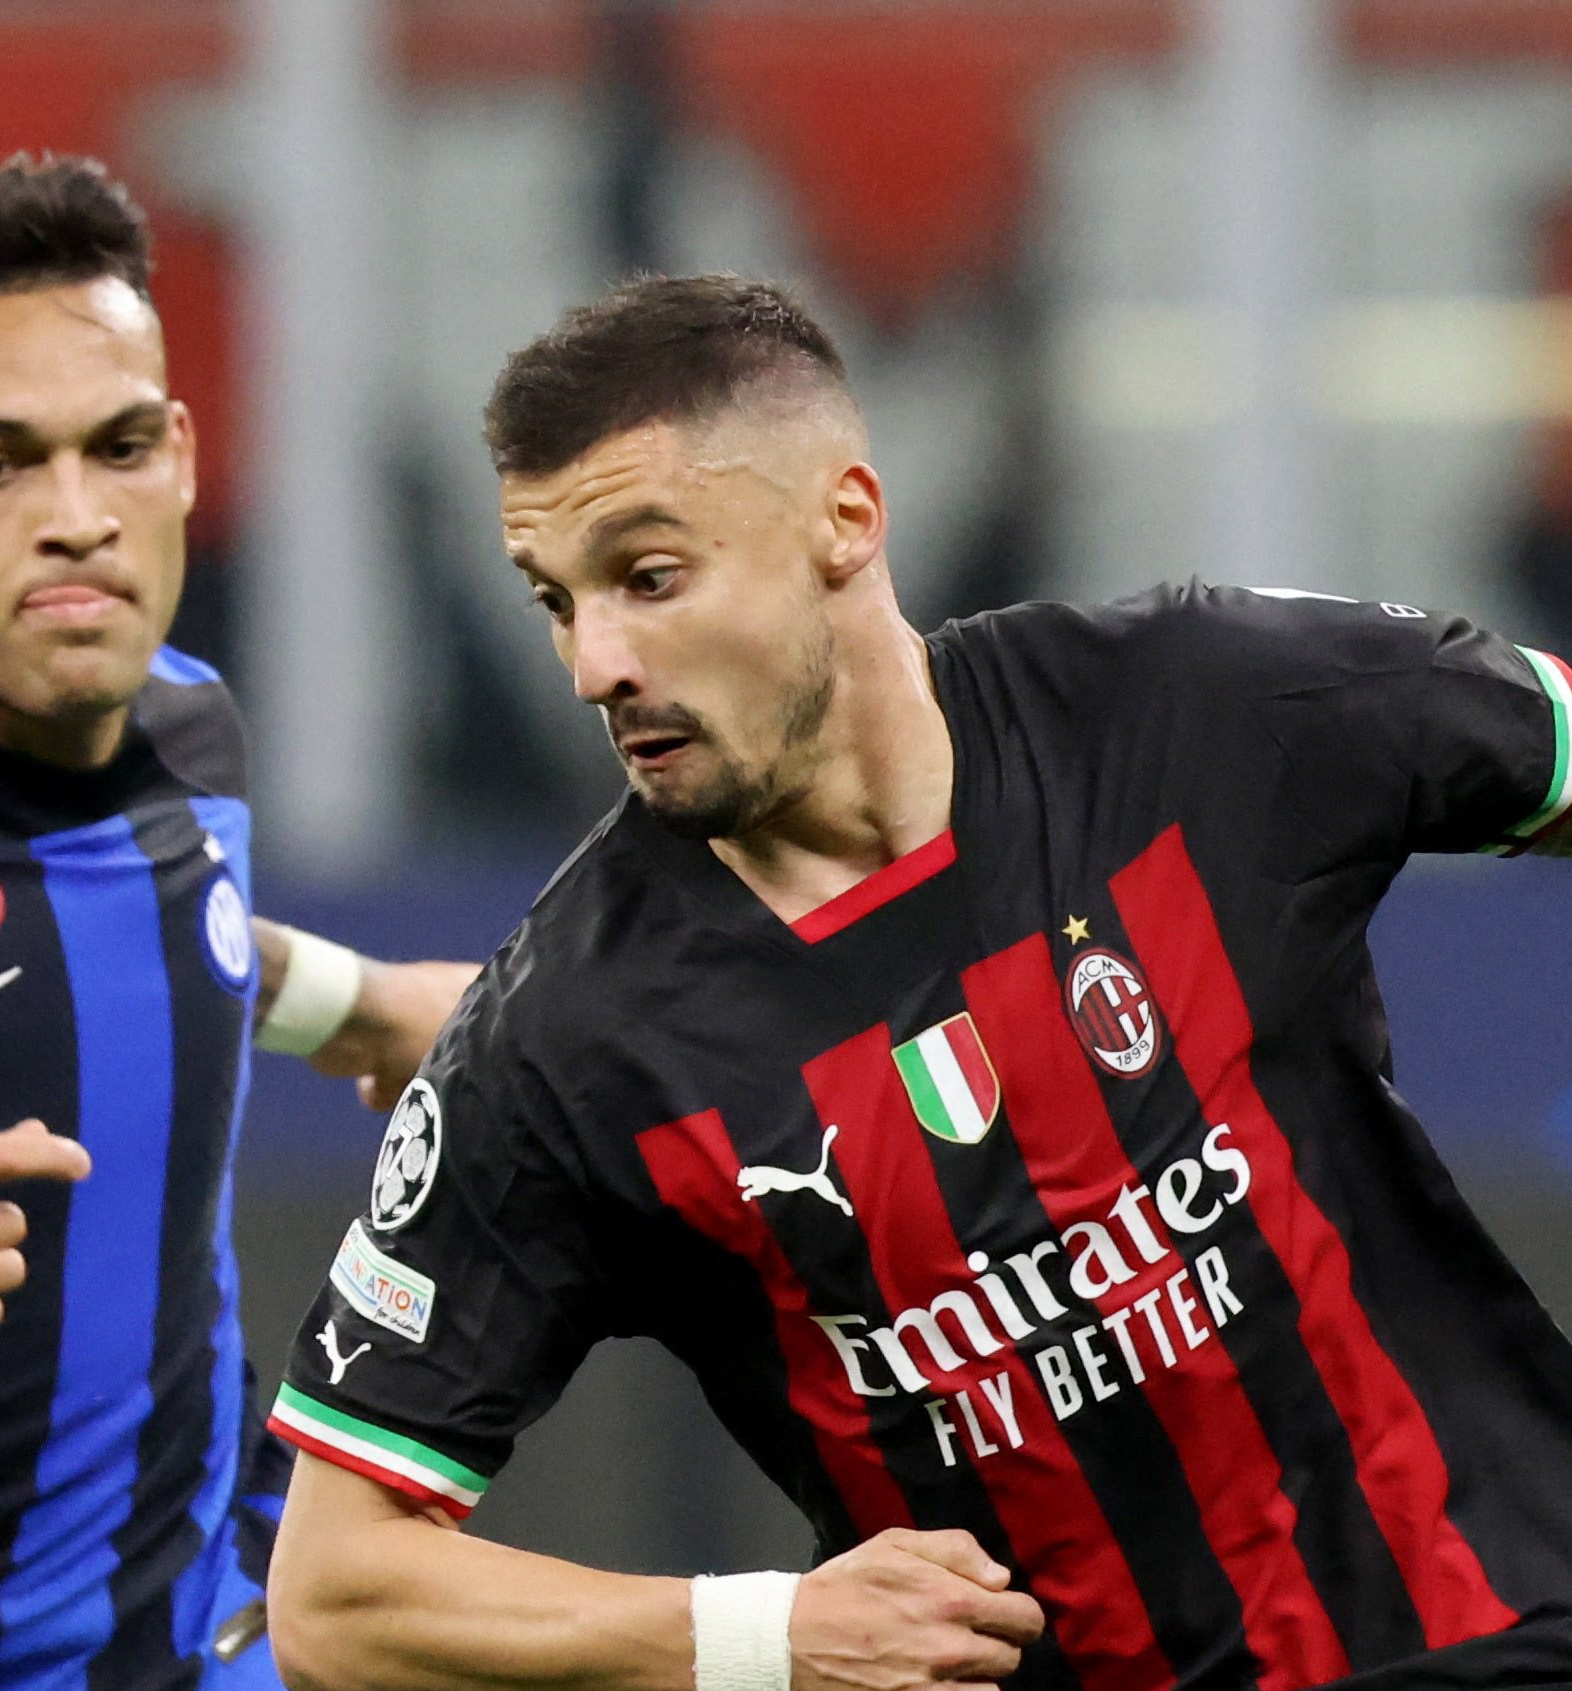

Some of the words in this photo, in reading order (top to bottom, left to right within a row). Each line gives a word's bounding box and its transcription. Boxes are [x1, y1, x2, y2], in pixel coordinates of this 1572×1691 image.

[1077, 958, 1119, 993] ACM
[1116, 1039, 1149, 1066] 1899
[810, 1123, 1251, 1396] Emirates
[924, 1371, 1024, 1467] FLY
[1035, 1246, 1244, 1422] BETTER
